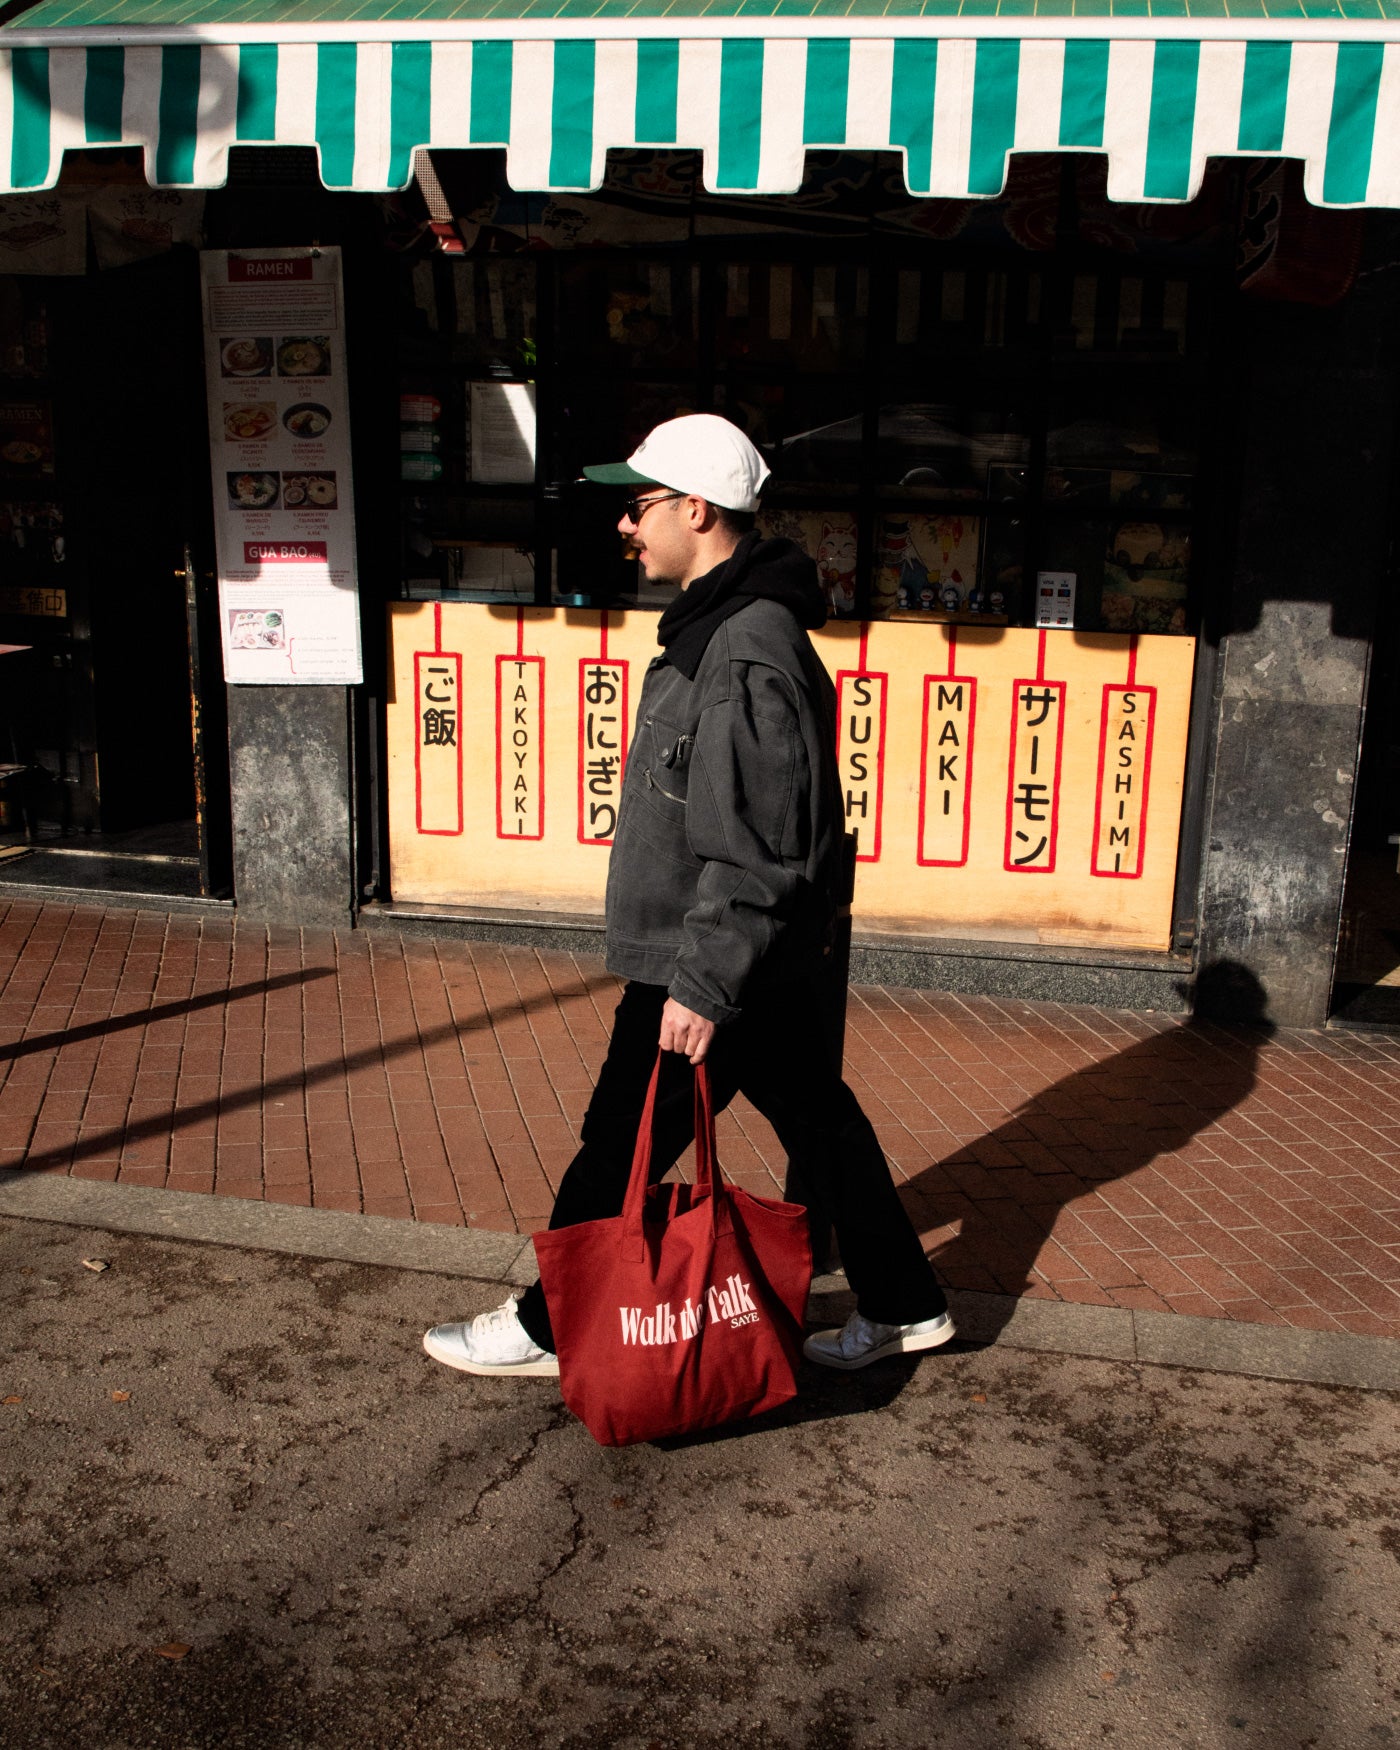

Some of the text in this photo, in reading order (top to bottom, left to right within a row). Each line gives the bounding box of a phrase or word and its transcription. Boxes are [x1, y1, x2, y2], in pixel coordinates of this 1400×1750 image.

[247, 262, 294, 276] RAMEN
[248, 546, 278, 559] GUA
[280, 546, 307, 558] BAO
[423, 667, 457, 747] ご飯
[512, 662, 527, 835] TAKOYAKI
[585, 665, 621, 839] おにぎり
[937, 685, 963, 816] MAKI
[1013, 687, 1057, 866] サーモン
[1109, 692, 1137, 873] SASHIMI
[619, 1272, 757, 1346] Walk the Talk
[730, 1311, 760, 1329] SAYE
